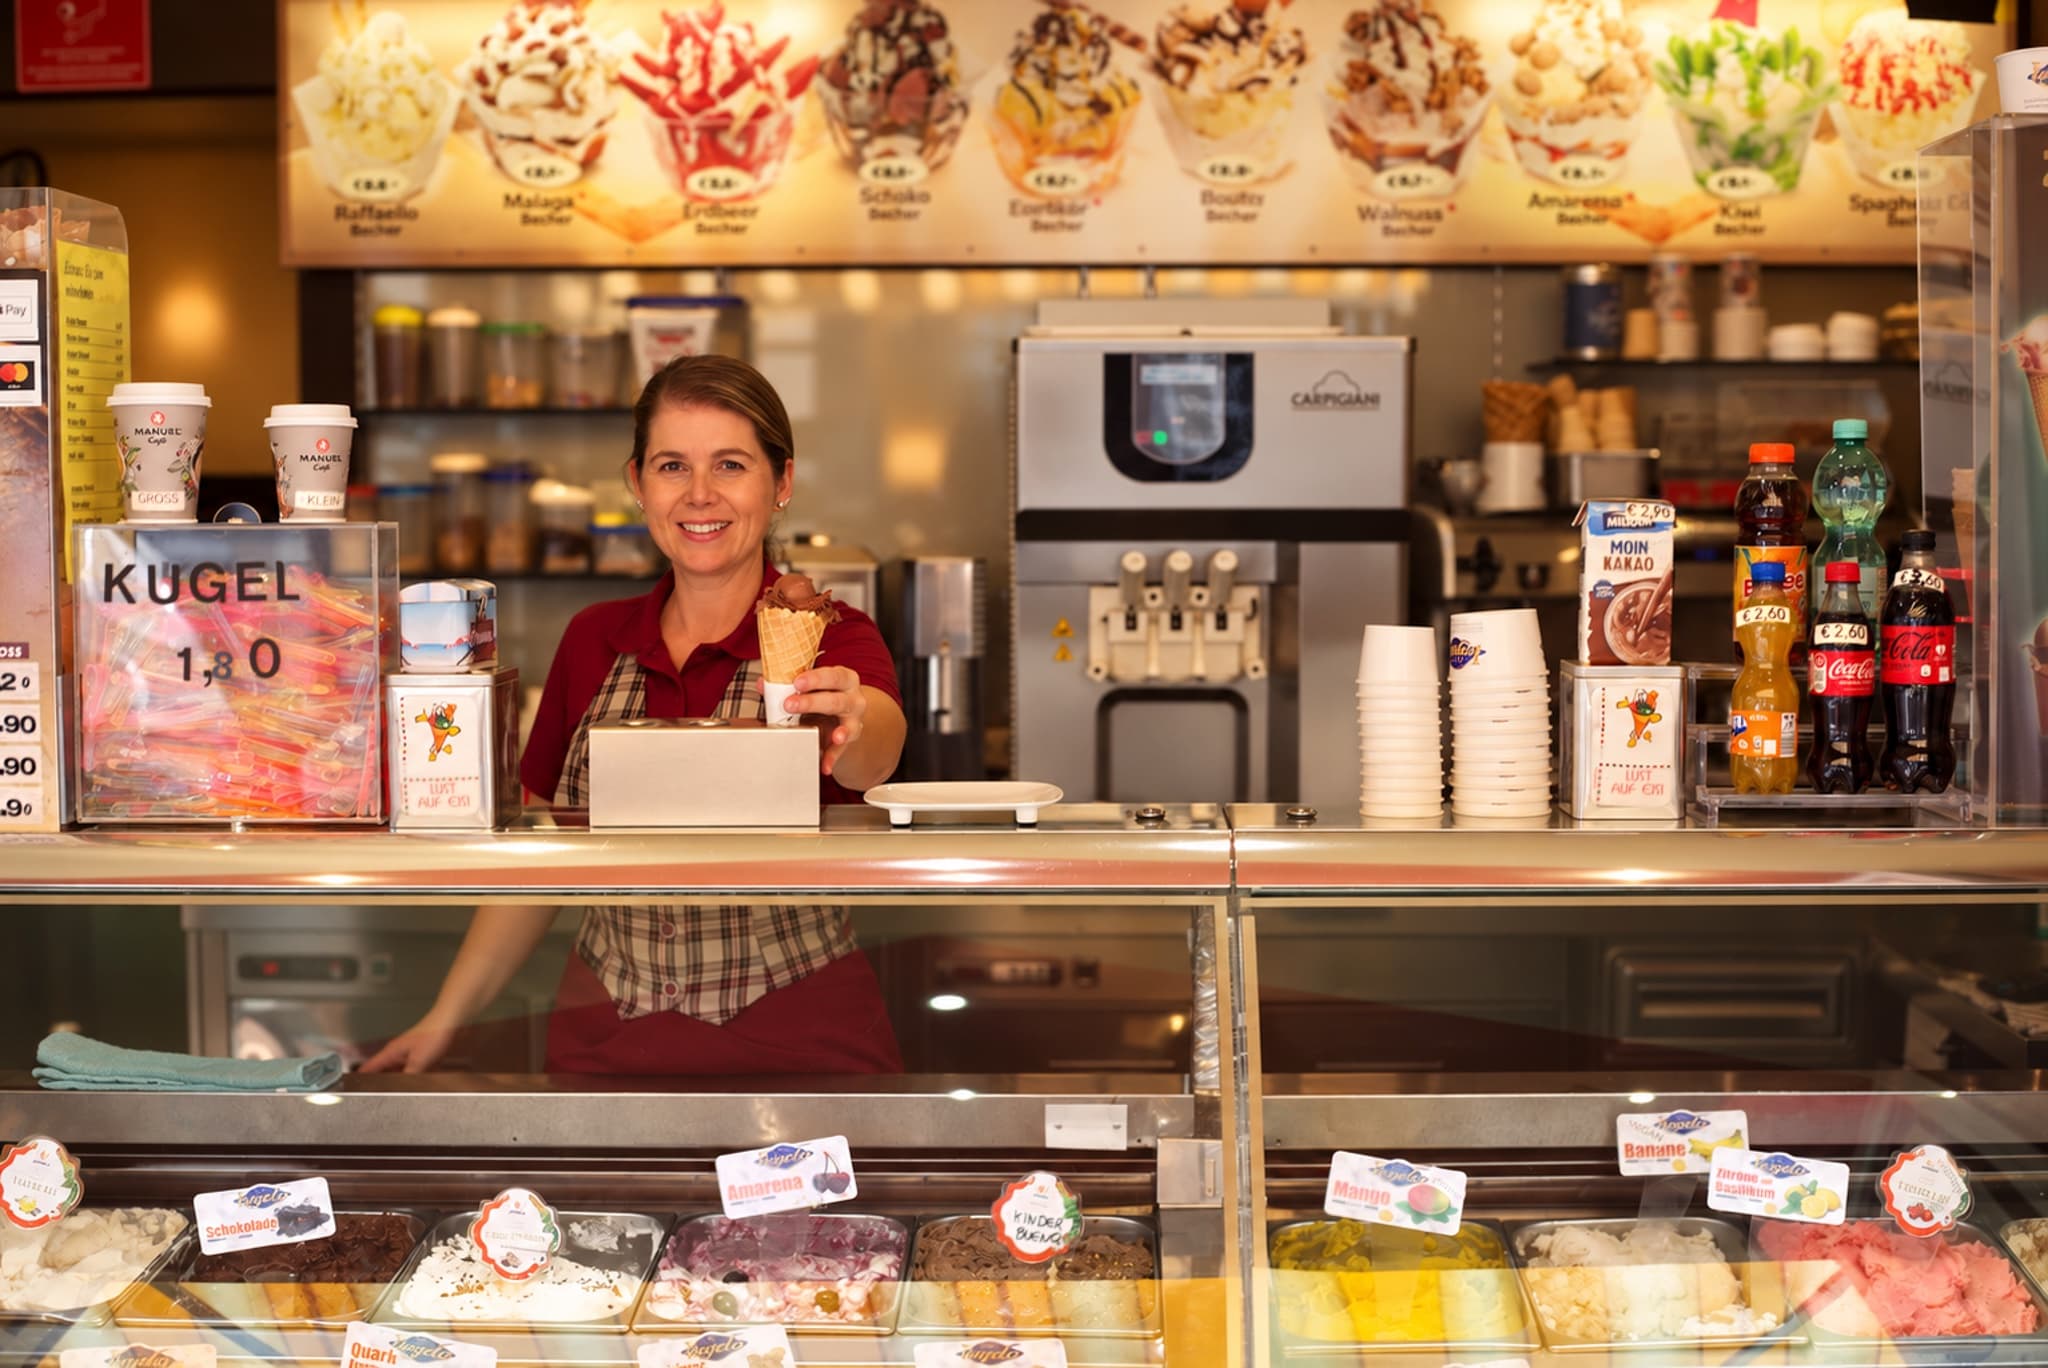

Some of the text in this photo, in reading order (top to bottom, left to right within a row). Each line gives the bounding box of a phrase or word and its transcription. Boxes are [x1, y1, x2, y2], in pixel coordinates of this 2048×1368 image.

[503, 193, 574, 211] Malaga
[860, 187, 931, 204] Schoko
[1528, 193, 1622, 209] Amarena
[334, 204, 419, 221] Raffaello
[683, 203, 758, 220] Erdbeer
[868, 208, 920, 221] Becher
[1205, 210, 1258, 222] Becher
[1357, 204, 1443, 222] Walnuss
[1719, 203, 1761, 220] Kiwi
[520, 213, 573, 226] Becher
[1031, 219, 1084, 232] Becher
[1556, 213, 1610, 226] Becher
[350, 224, 402, 237] Becher
[1382, 224, 1435, 237] Becher
[1714, 223, 1766, 236] Becher
[5, 304, 27, 317] Pay
[1291, 393, 1381, 408] CARPIGIANI
[134, 427, 182, 437] MANUEL
[300, 454, 342, 463] MANUEL
[138, 493, 179, 504] GROSS
[307, 495, 341, 506] KLEIN
[1611, 540, 1648, 554] MOIN
[1603, 556, 1654, 571] KAKAO
[103, 561, 300, 605] KUGEL
[1755, 607, 1786, 621] 2,60
[1834, 624, 1865, 640] 2,60
[1625, 769, 1652, 782] LUST
[430, 782, 455, 795] LUST
[1611, 783, 1636, 795] AUF
[1624, 1142, 1686, 1159] Banane
[1716, 1167, 1759, 1183] Zitrone
[727, 1176, 803, 1201] Amarena
[1333, 1180, 1391, 1206] Mango
[1714, 1181, 1776, 1200] Basilikum
[1014, 1210, 1064, 1230] KINDER
[206, 1217, 277, 1239] Schokolade
[351, 1342, 397, 1366] Quark
